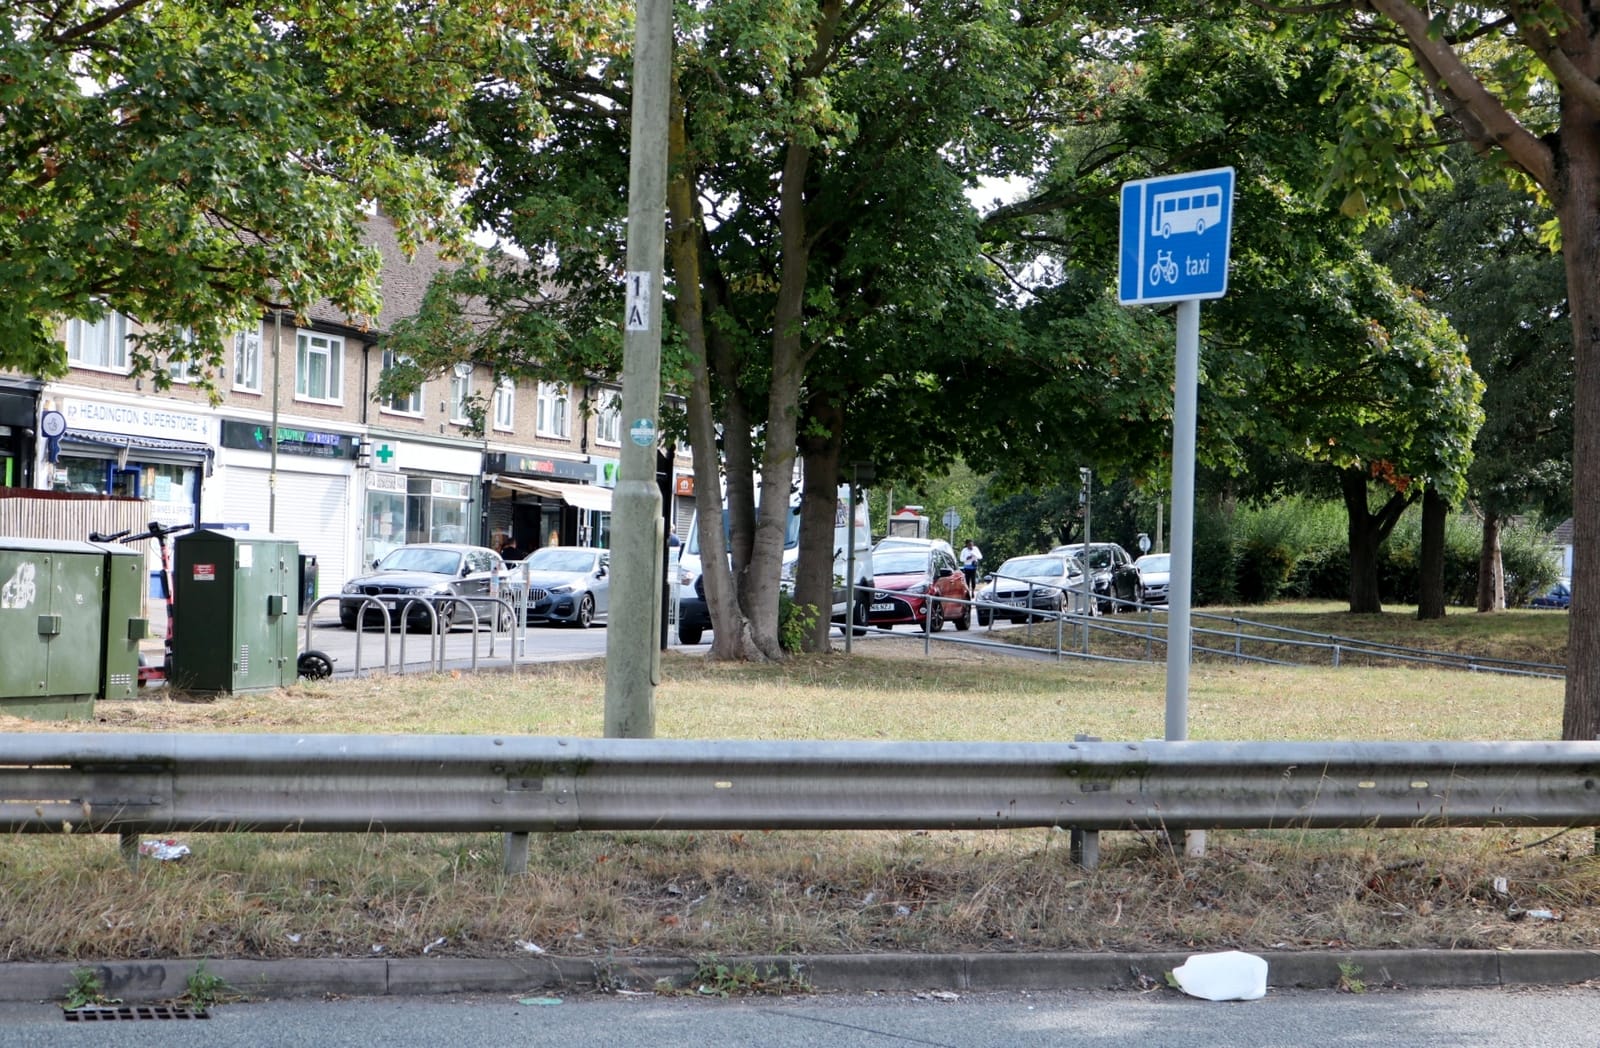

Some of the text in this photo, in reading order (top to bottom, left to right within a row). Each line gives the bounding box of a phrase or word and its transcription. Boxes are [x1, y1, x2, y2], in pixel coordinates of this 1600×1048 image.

[1186, 252, 1210, 276] taxi
[633, 276, 641, 297] 1
[628, 305, 643, 326] A
[80, 404, 139, 424] HEADINGTON
[143, 411, 198, 432] SUPERSTORE
